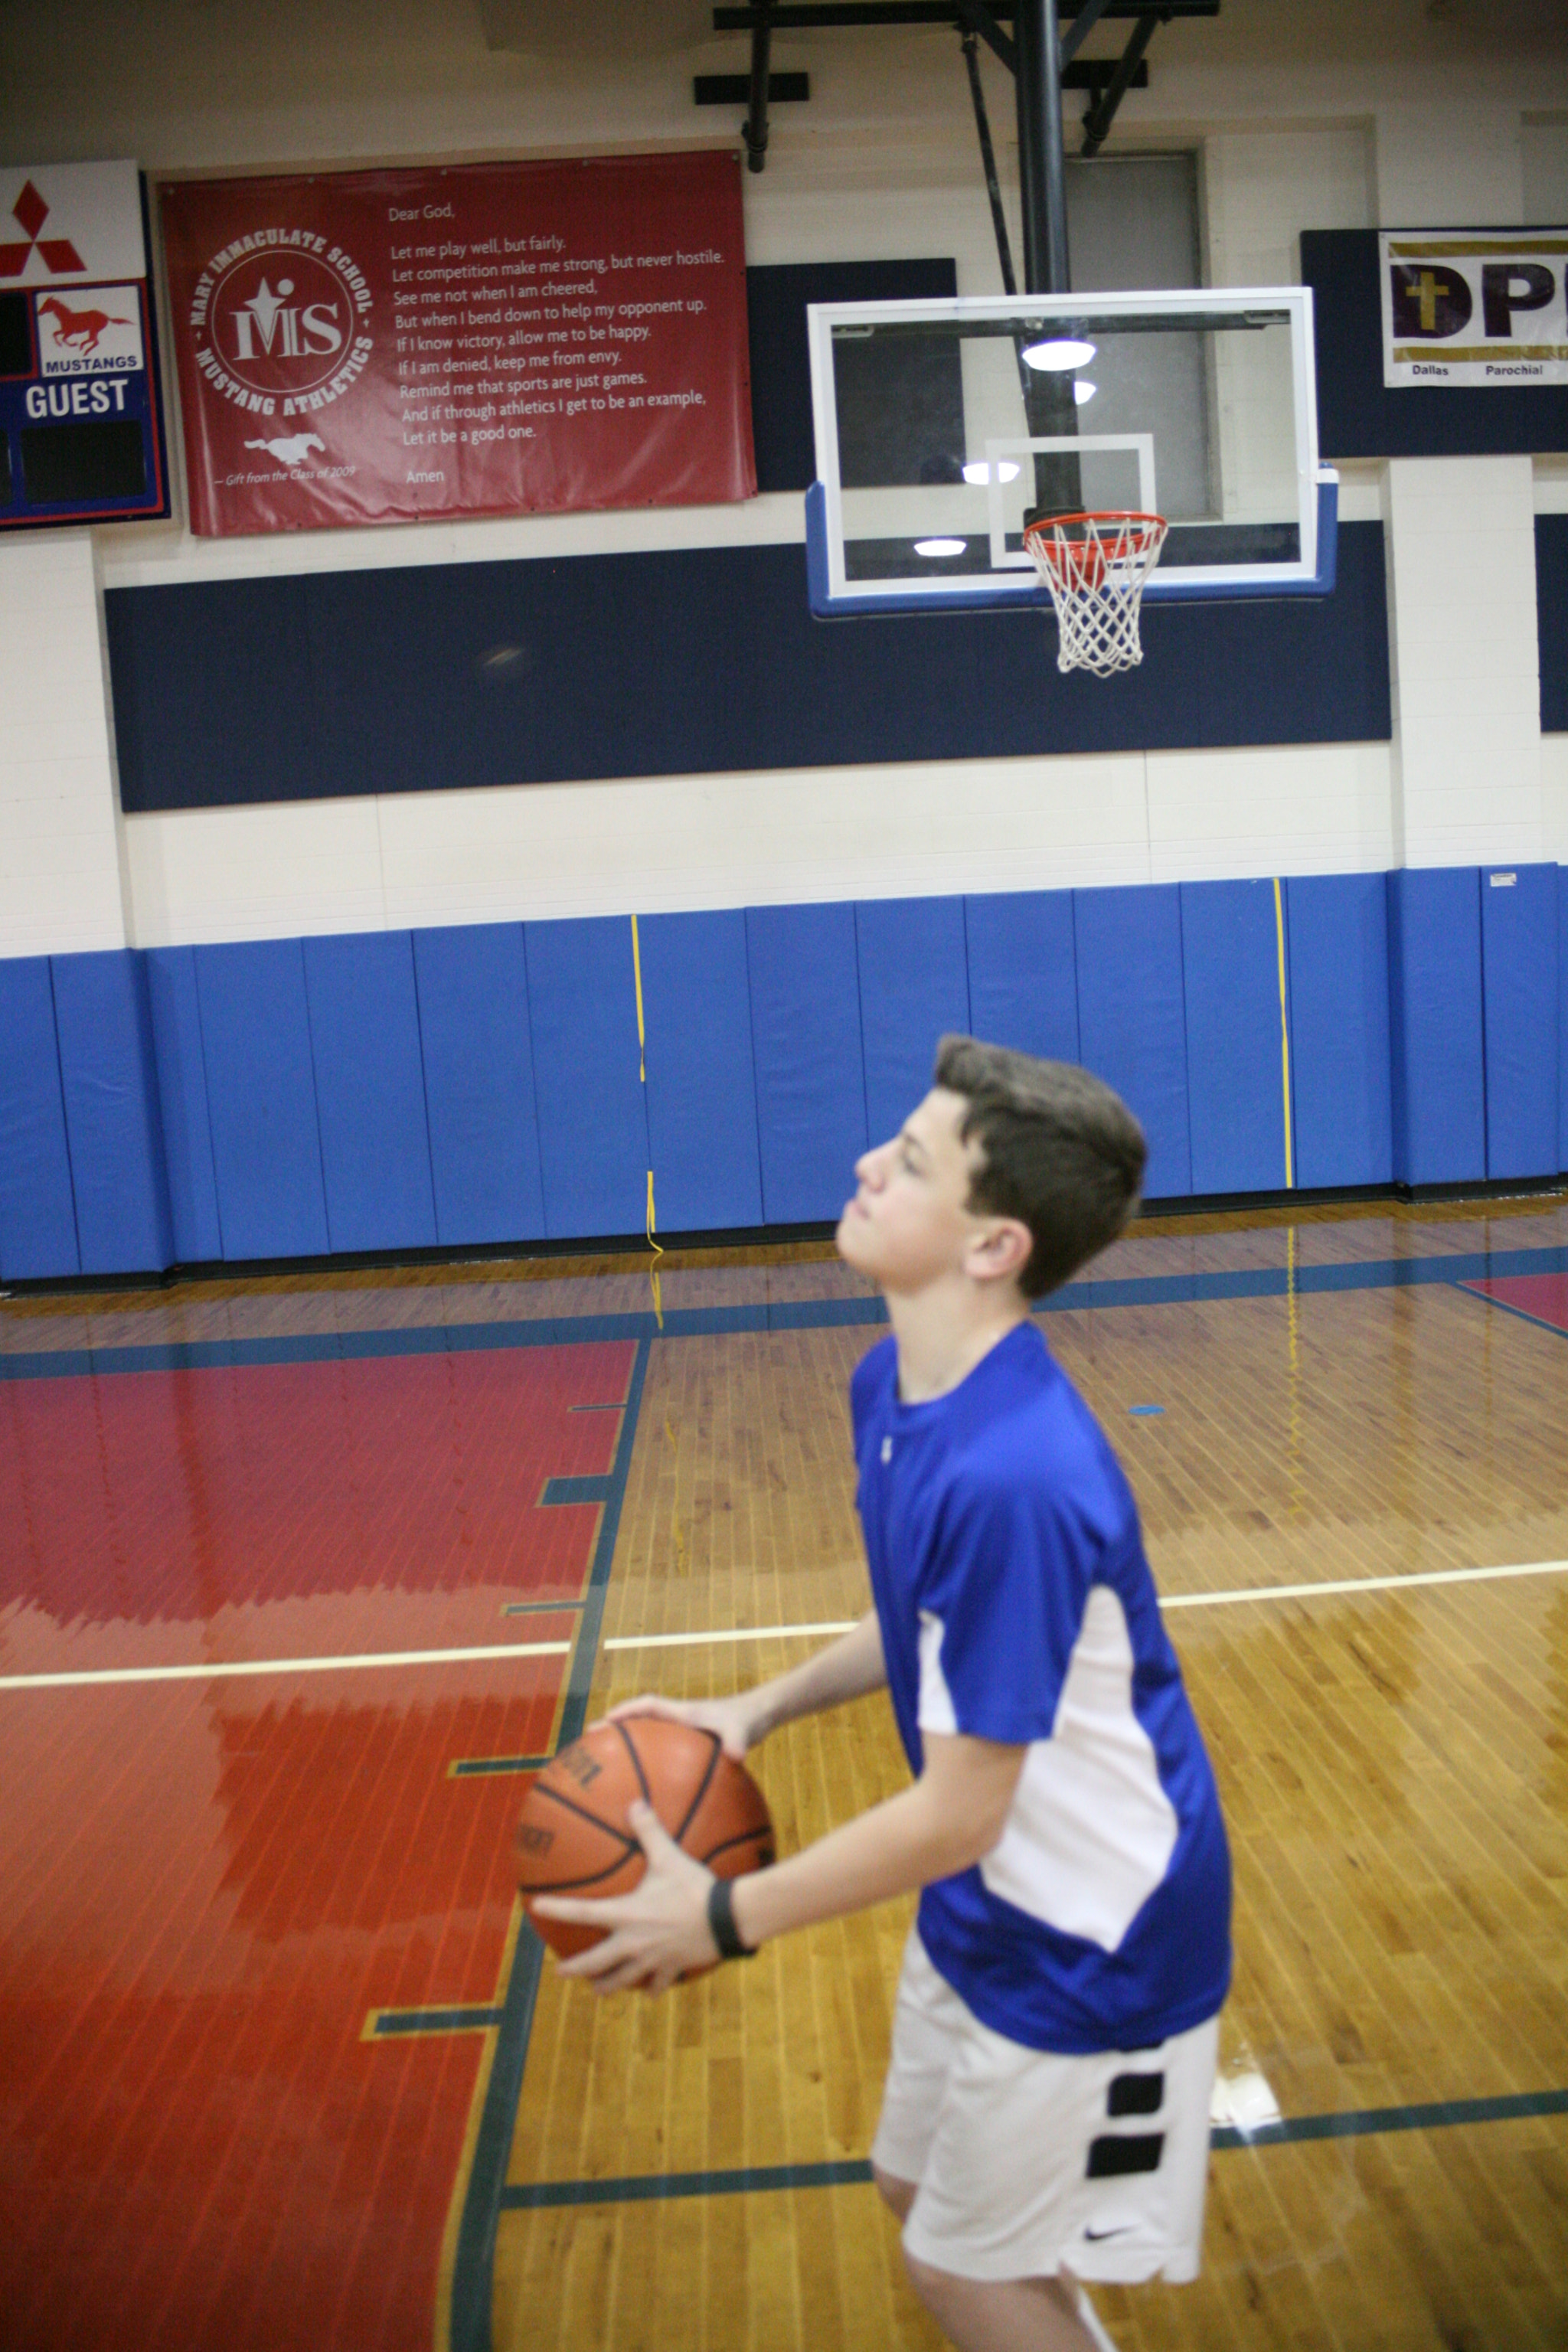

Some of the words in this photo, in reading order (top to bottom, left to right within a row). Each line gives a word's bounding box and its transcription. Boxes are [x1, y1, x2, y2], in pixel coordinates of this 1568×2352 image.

[388, 207, 420, 221] Dear
[391, 247, 412, 260] Let
[416, 247, 436, 257] me
[439, 240, 466, 260] play
[504, 238, 526, 253] but
[530, 234, 567, 253] fairly.
[190, 272, 215, 325] MARY
[208, 228, 328, 274] IMMACULATE
[326, 247, 374, 313] SCHOOL
[393, 270, 413, 283] Let
[416, 264, 498, 283] competition
[501, 260, 536, 276] make
[540, 261, 560, 273] me
[612, 253, 633, 269] but
[637, 254, 673, 266] never
[677, 249, 724, 265] hostile.
[394, 291, 417, 305] See
[421, 292, 441, 303] me
[446, 289, 468, 302] not
[472, 286, 507, 300] when
[518, 286, 537, 298] am
[1390, 263, 1568, 339] DP
[395, 315, 418, 328] But
[422, 311, 457, 326] when
[468, 308, 501, 325] bend
[505, 307, 541, 322] down
[544, 307, 559, 319] to
[562, 303, 591, 322] help
[595, 305, 615, 320] my
[619, 299, 683, 318] opponent
[687, 300, 707, 315] up.
[397, 337, 407, 352] If
[418, 335, 453, 351] know
[508, 330, 544, 345] allow
[547, 331, 567, 342] me
[571, 329, 586, 341] to
[590, 325, 606, 340] be
[609, 324, 652, 342] happy.
[46, 354, 138, 373] MUSTANGS
[399, 360, 409, 375] If
[420, 362, 439, 374] am
[495, 355, 526, 372] keep
[529, 355, 550, 367] me
[553, 350, 585, 365] from
[589, 351, 622, 366] envy.
[1413, 364, 1449, 376] Dallas
[1486, 364, 1544, 376] Parochial
[195, 348, 276, 416] MUSTANG
[283, 336, 373, 416] ATHLETICS
[400, 381, 449, 399] Remind
[453, 384, 473, 395] me
[478, 379, 503, 394] that
[508, 377, 548, 395] sports
[551, 377, 572, 390] are
[576, 374, 599, 391] just
[603, 373, 647, 390] games.
[26, 378, 129, 419] GUEST
[402, 405, 428, 422] And
[432, 404, 442, 419] if
[444, 402, 496, 421] through
[499, 399, 555, 416] athletics
[567, 400, 587, 416] get
[591, 397, 606, 410] to
[609, 394, 625, 408] be
[629, 396, 644, 407] an
[403, 432, 424, 446] Let
[427, 430, 437, 443] it
[440, 428, 457, 443] be
[460, 431, 468, 442] a
[471, 424, 505, 446] good
[508, 426, 537, 439] one.
[226, 472, 245, 485] Gift
[246, 472, 270, 484] from
[272, 470, 288, 482] the
[290, 469, 315, 480] Class
[330, 466, 356, 478] 2009
[406, 471, 445, 483] Amen
